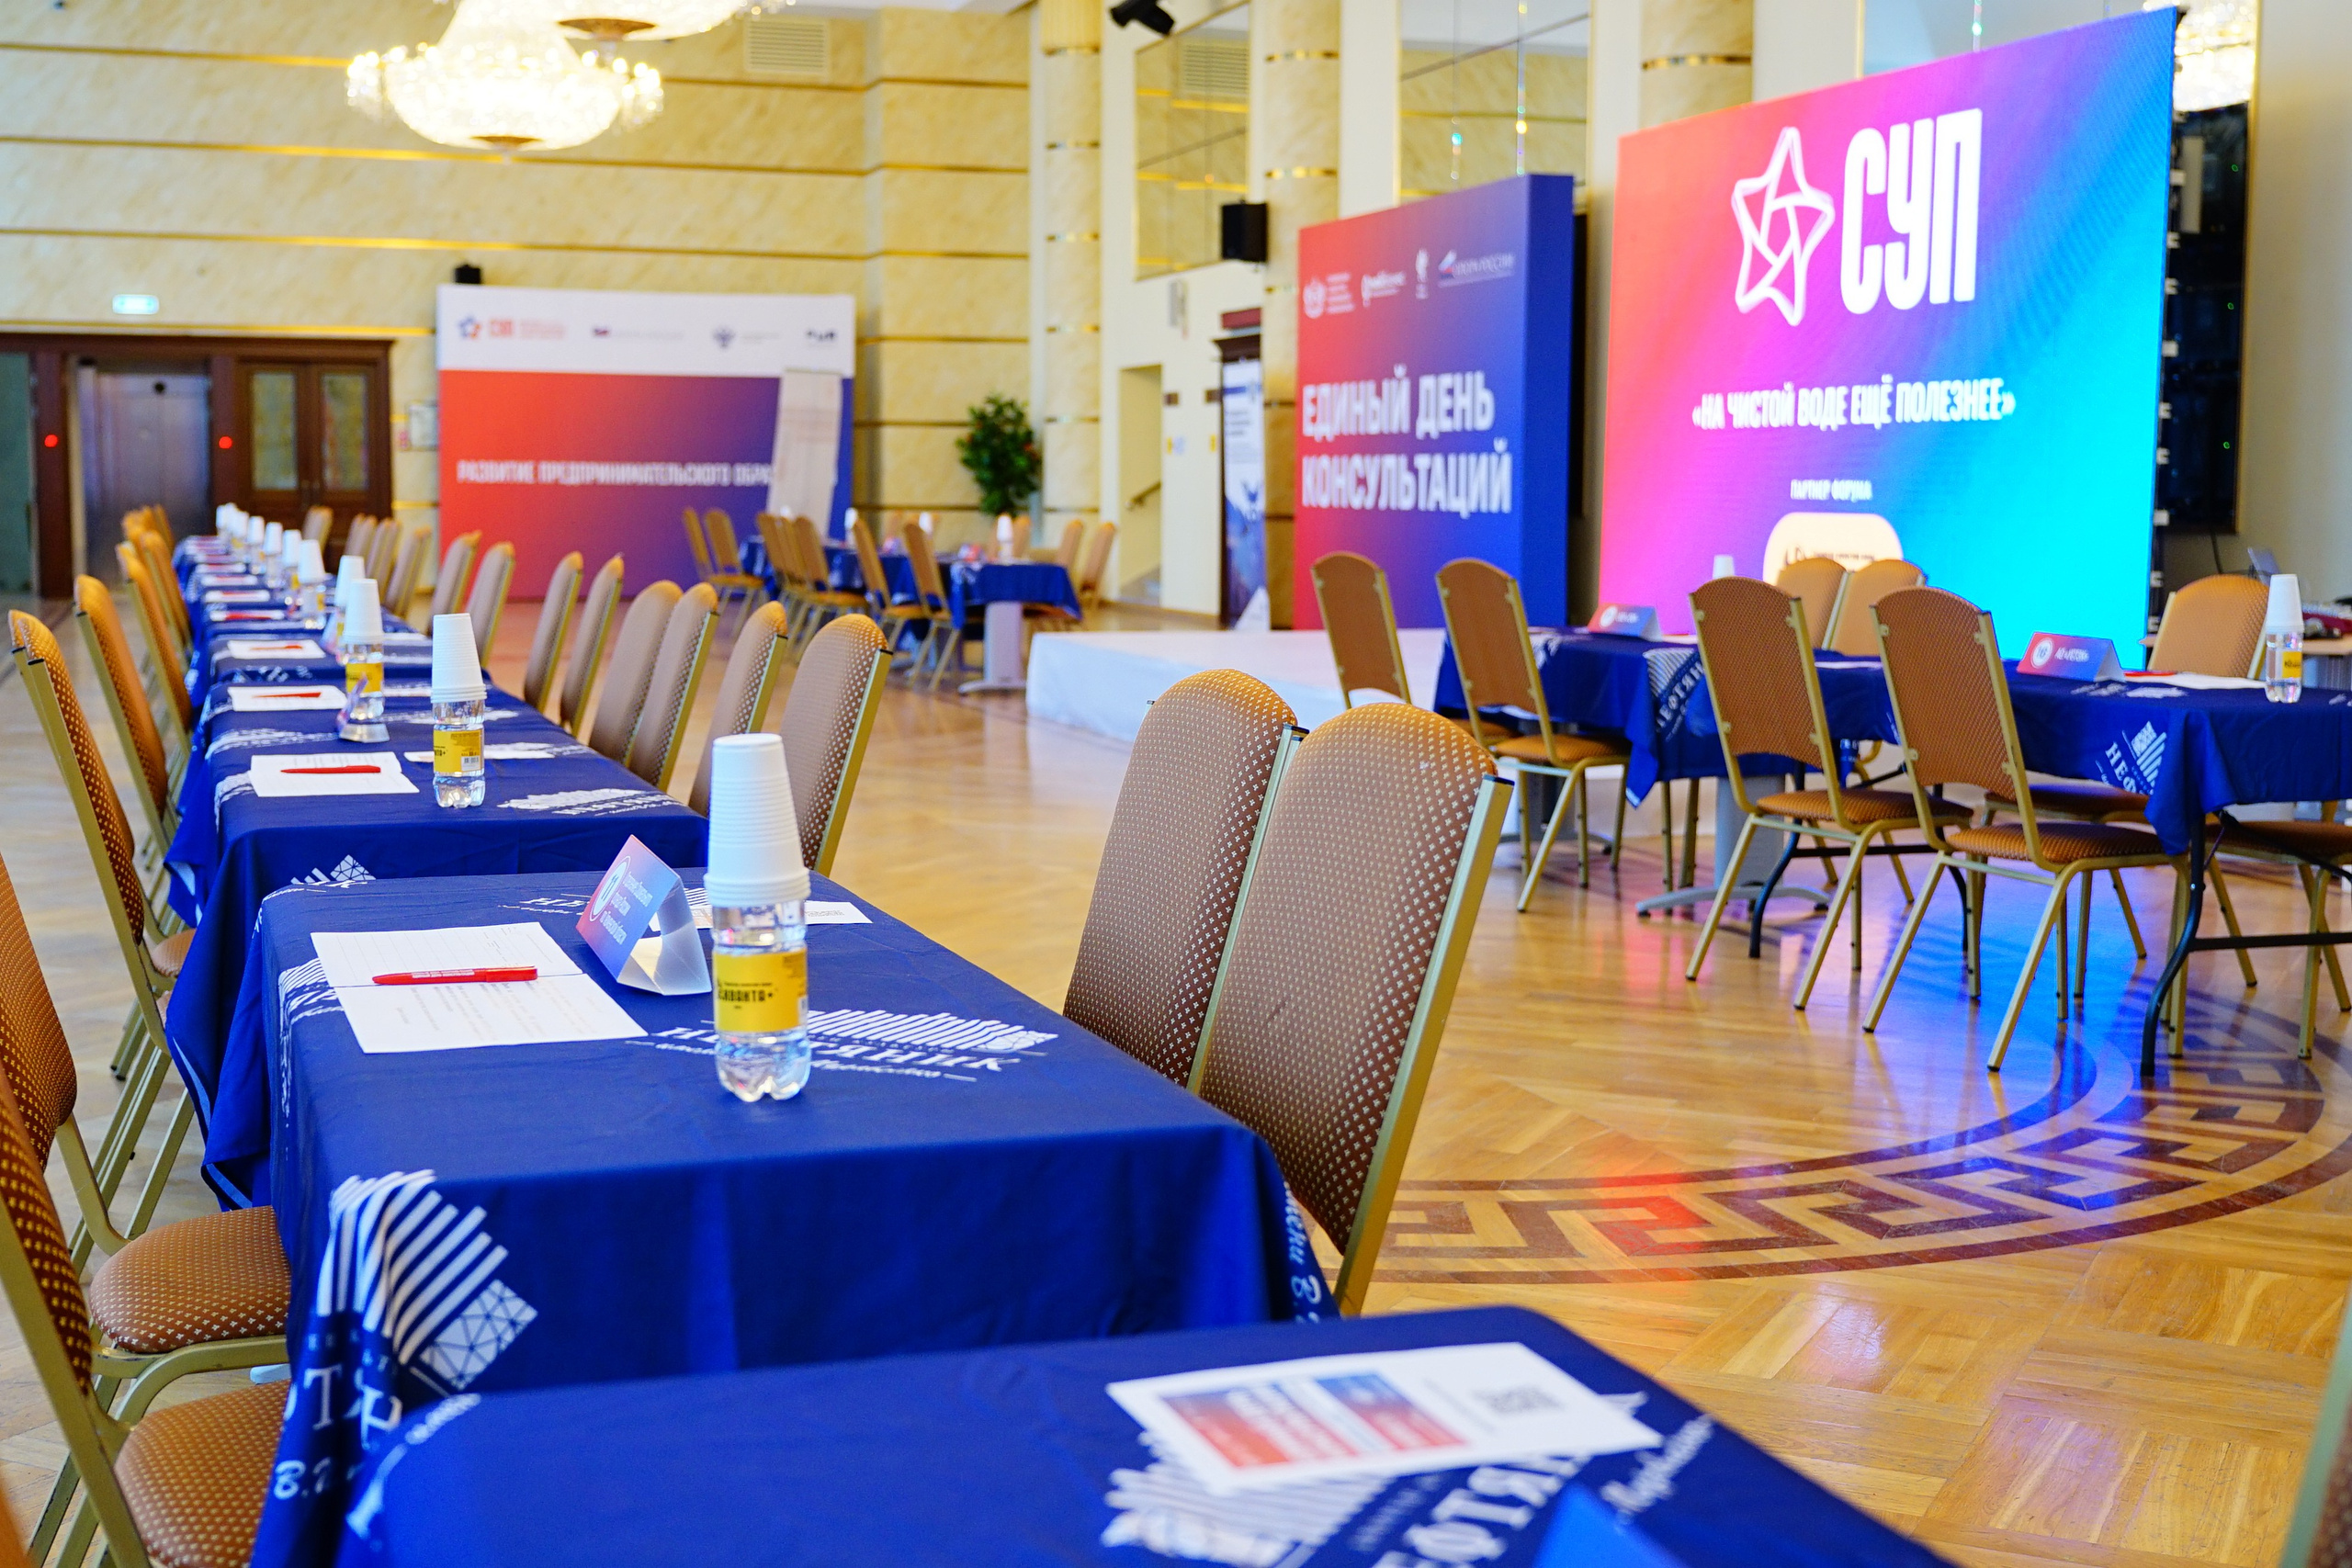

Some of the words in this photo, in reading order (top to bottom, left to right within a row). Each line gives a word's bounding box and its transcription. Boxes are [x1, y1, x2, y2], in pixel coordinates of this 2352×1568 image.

[1840, 108, 1983, 314] СУП
[1303, 363, 1410, 443] ЕДИНЫЙ
[1416, 370, 1495, 440] ДЕНЬ
[1727, 382, 1795, 429] ЧИСТОЙ
[1797, 386, 1849, 431] ВОДЕ
[1850, 374, 1894, 430] ЕЩЁ
[1302, 436, 1513, 520] КОНСУЛЬТАЦИЙ
